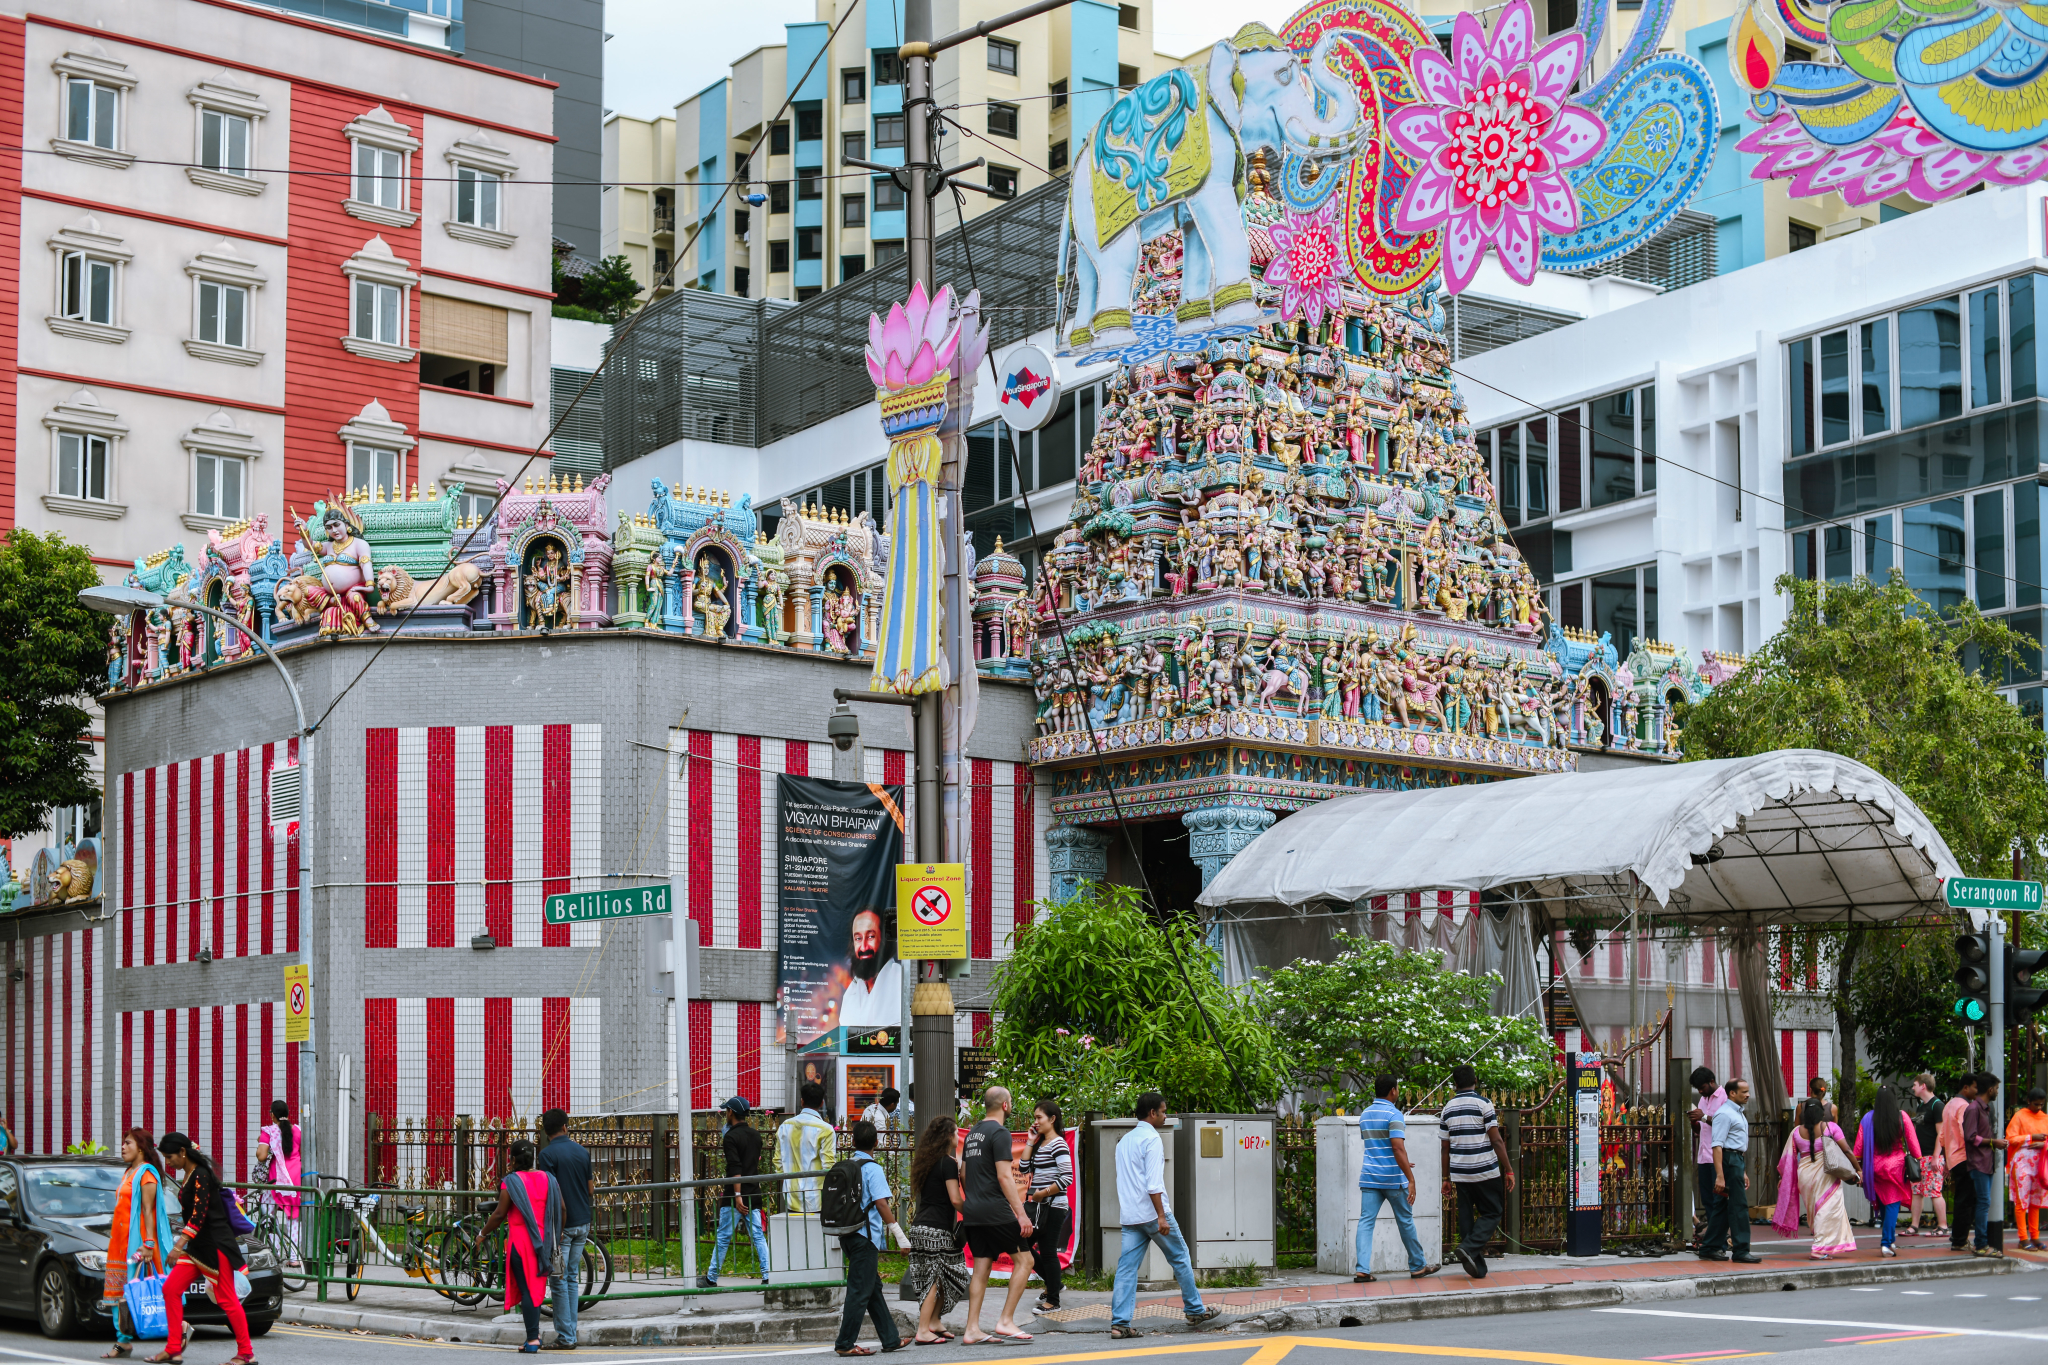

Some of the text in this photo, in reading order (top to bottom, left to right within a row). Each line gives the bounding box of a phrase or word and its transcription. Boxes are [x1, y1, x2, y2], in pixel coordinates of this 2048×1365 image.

[1005, 378, 1048, 396] YourSingapore
[784, 810, 880, 830] VIGYAN BHAIRAV
[785, 826, 812, 835] SCIENCE
[823, 830, 877, 840] CONSCIOUSNESS
[784, 855, 828, 864] SINGAPORE
[1953, 881, 2037, 905] Serangoon Rd
[555, 889, 666, 920] Belilios Rd
[1579, 1077, 1598, 1087] INDIA
